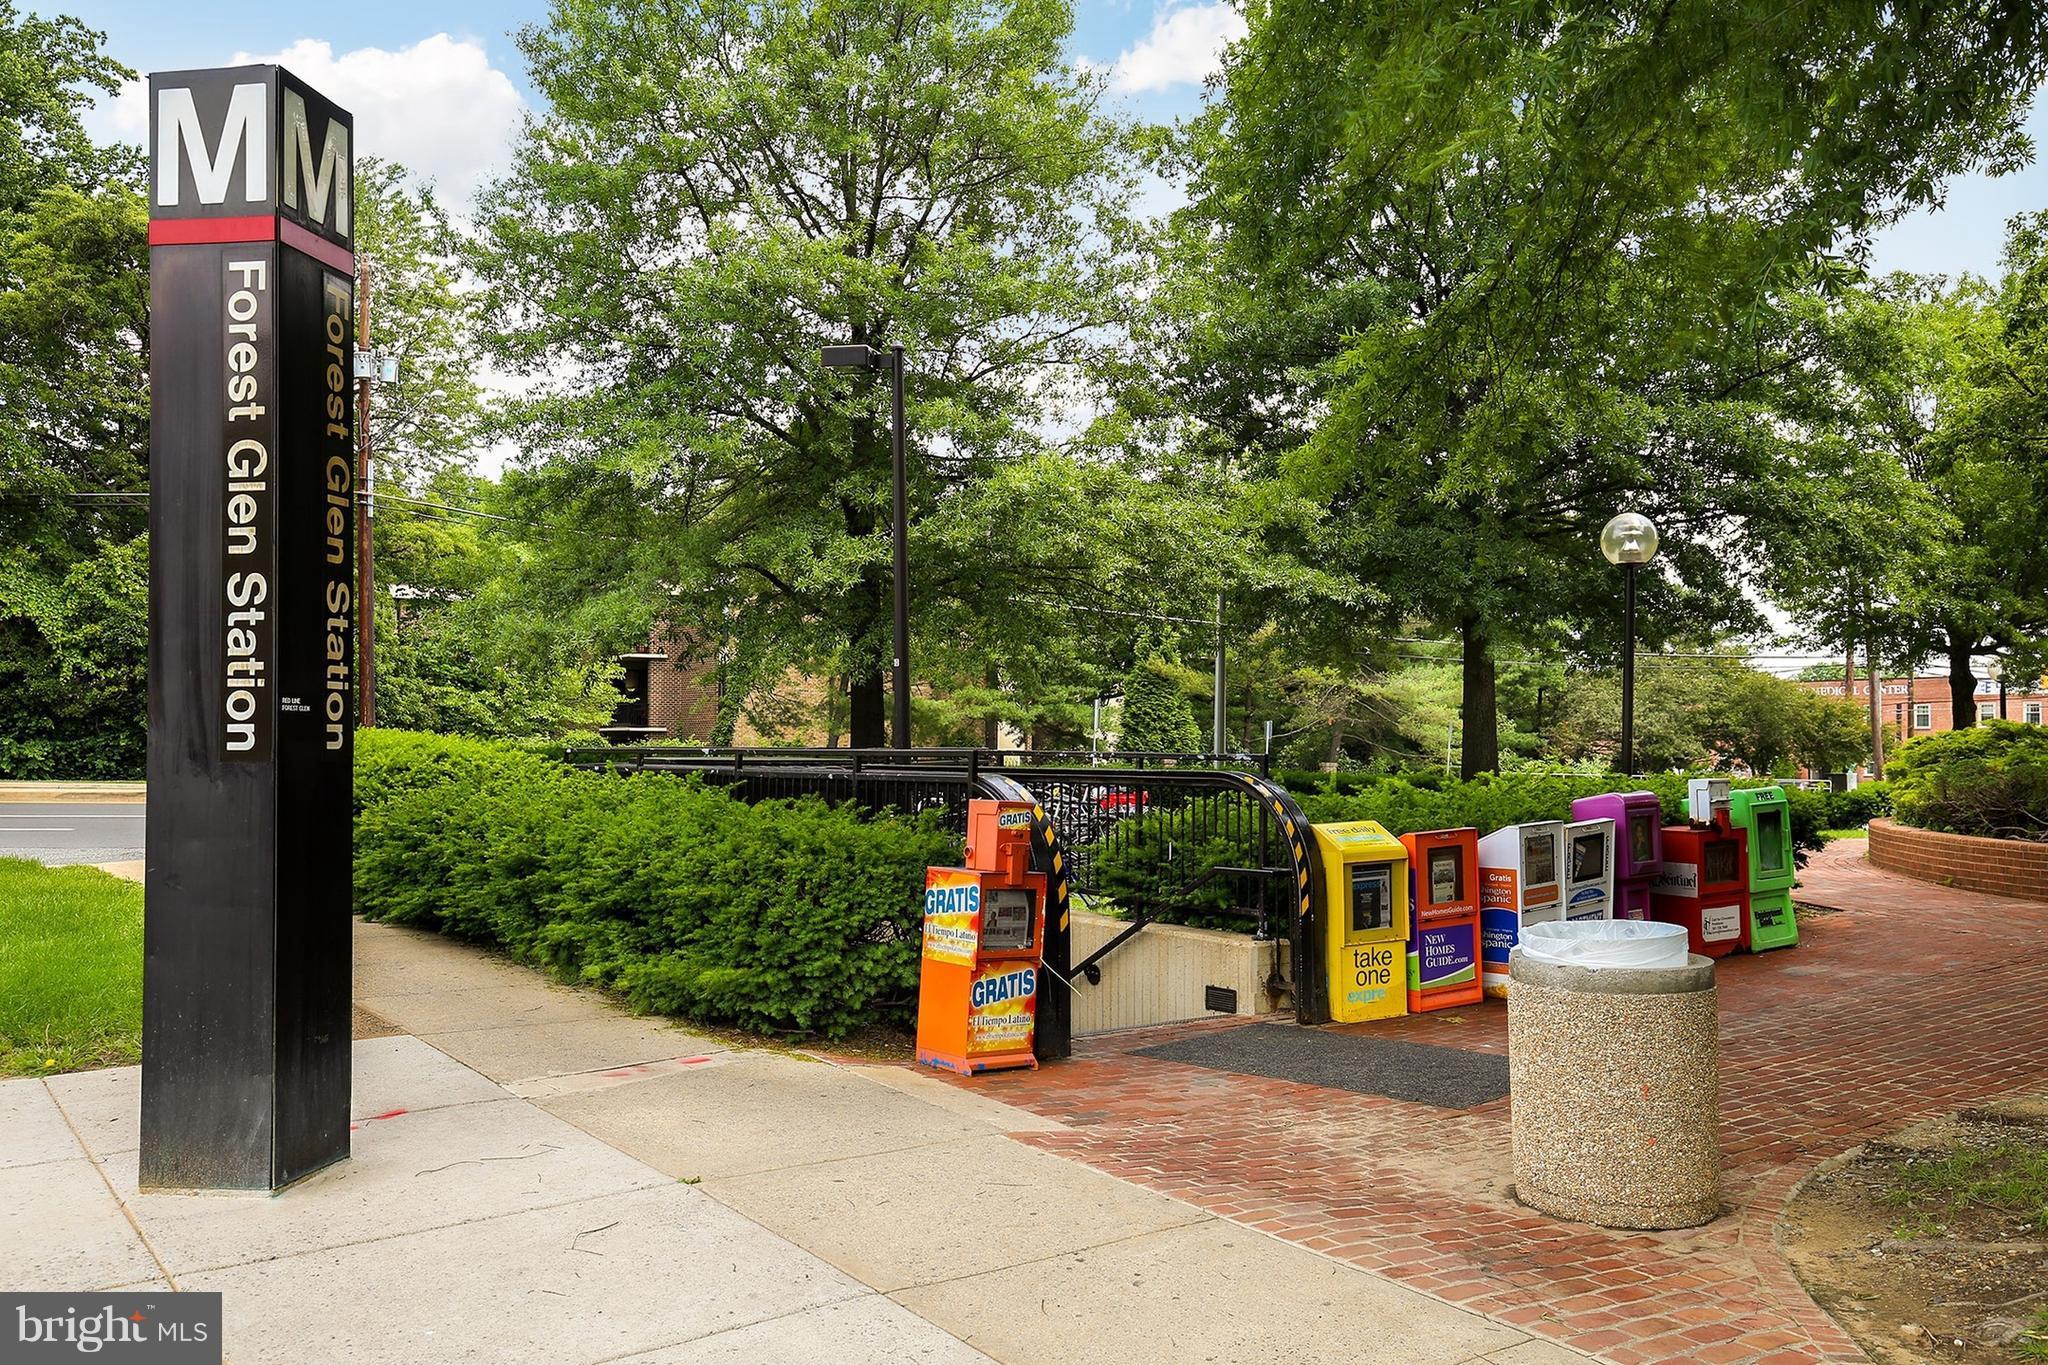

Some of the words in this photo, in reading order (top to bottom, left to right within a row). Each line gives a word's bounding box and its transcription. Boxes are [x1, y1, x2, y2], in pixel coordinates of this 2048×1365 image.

[157, 82, 267, 207] M
[284, 86, 348, 238] M
[227, 260, 267, 422] Forest
[326, 283, 350, 440] Forest
[227, 439, 268, 555] Glen
[326, 456, 350, 565] Glen
[226, 572, 268, 751] Station
[326, 581, 350, 750] Station
[1755, 791, 1774, 801] FREE
[999, 811, 1031, 826] GRATIS
[1489, 873, 1512, 883] Gratis
[925, 885, 979, 915] GRATIS
[1425, 934, 1445, 946] NEW
[1425, 944, 1456, 957] HOMES
[1353, 947, 1393, 968] take
[1426, 955, 1469, 968] GUIDE.com
[971, 967, 1036, 1008] GRATIS
[1356, 967, 1391, 987] one
[981, 1014, 1008, 1028] Tiempo
